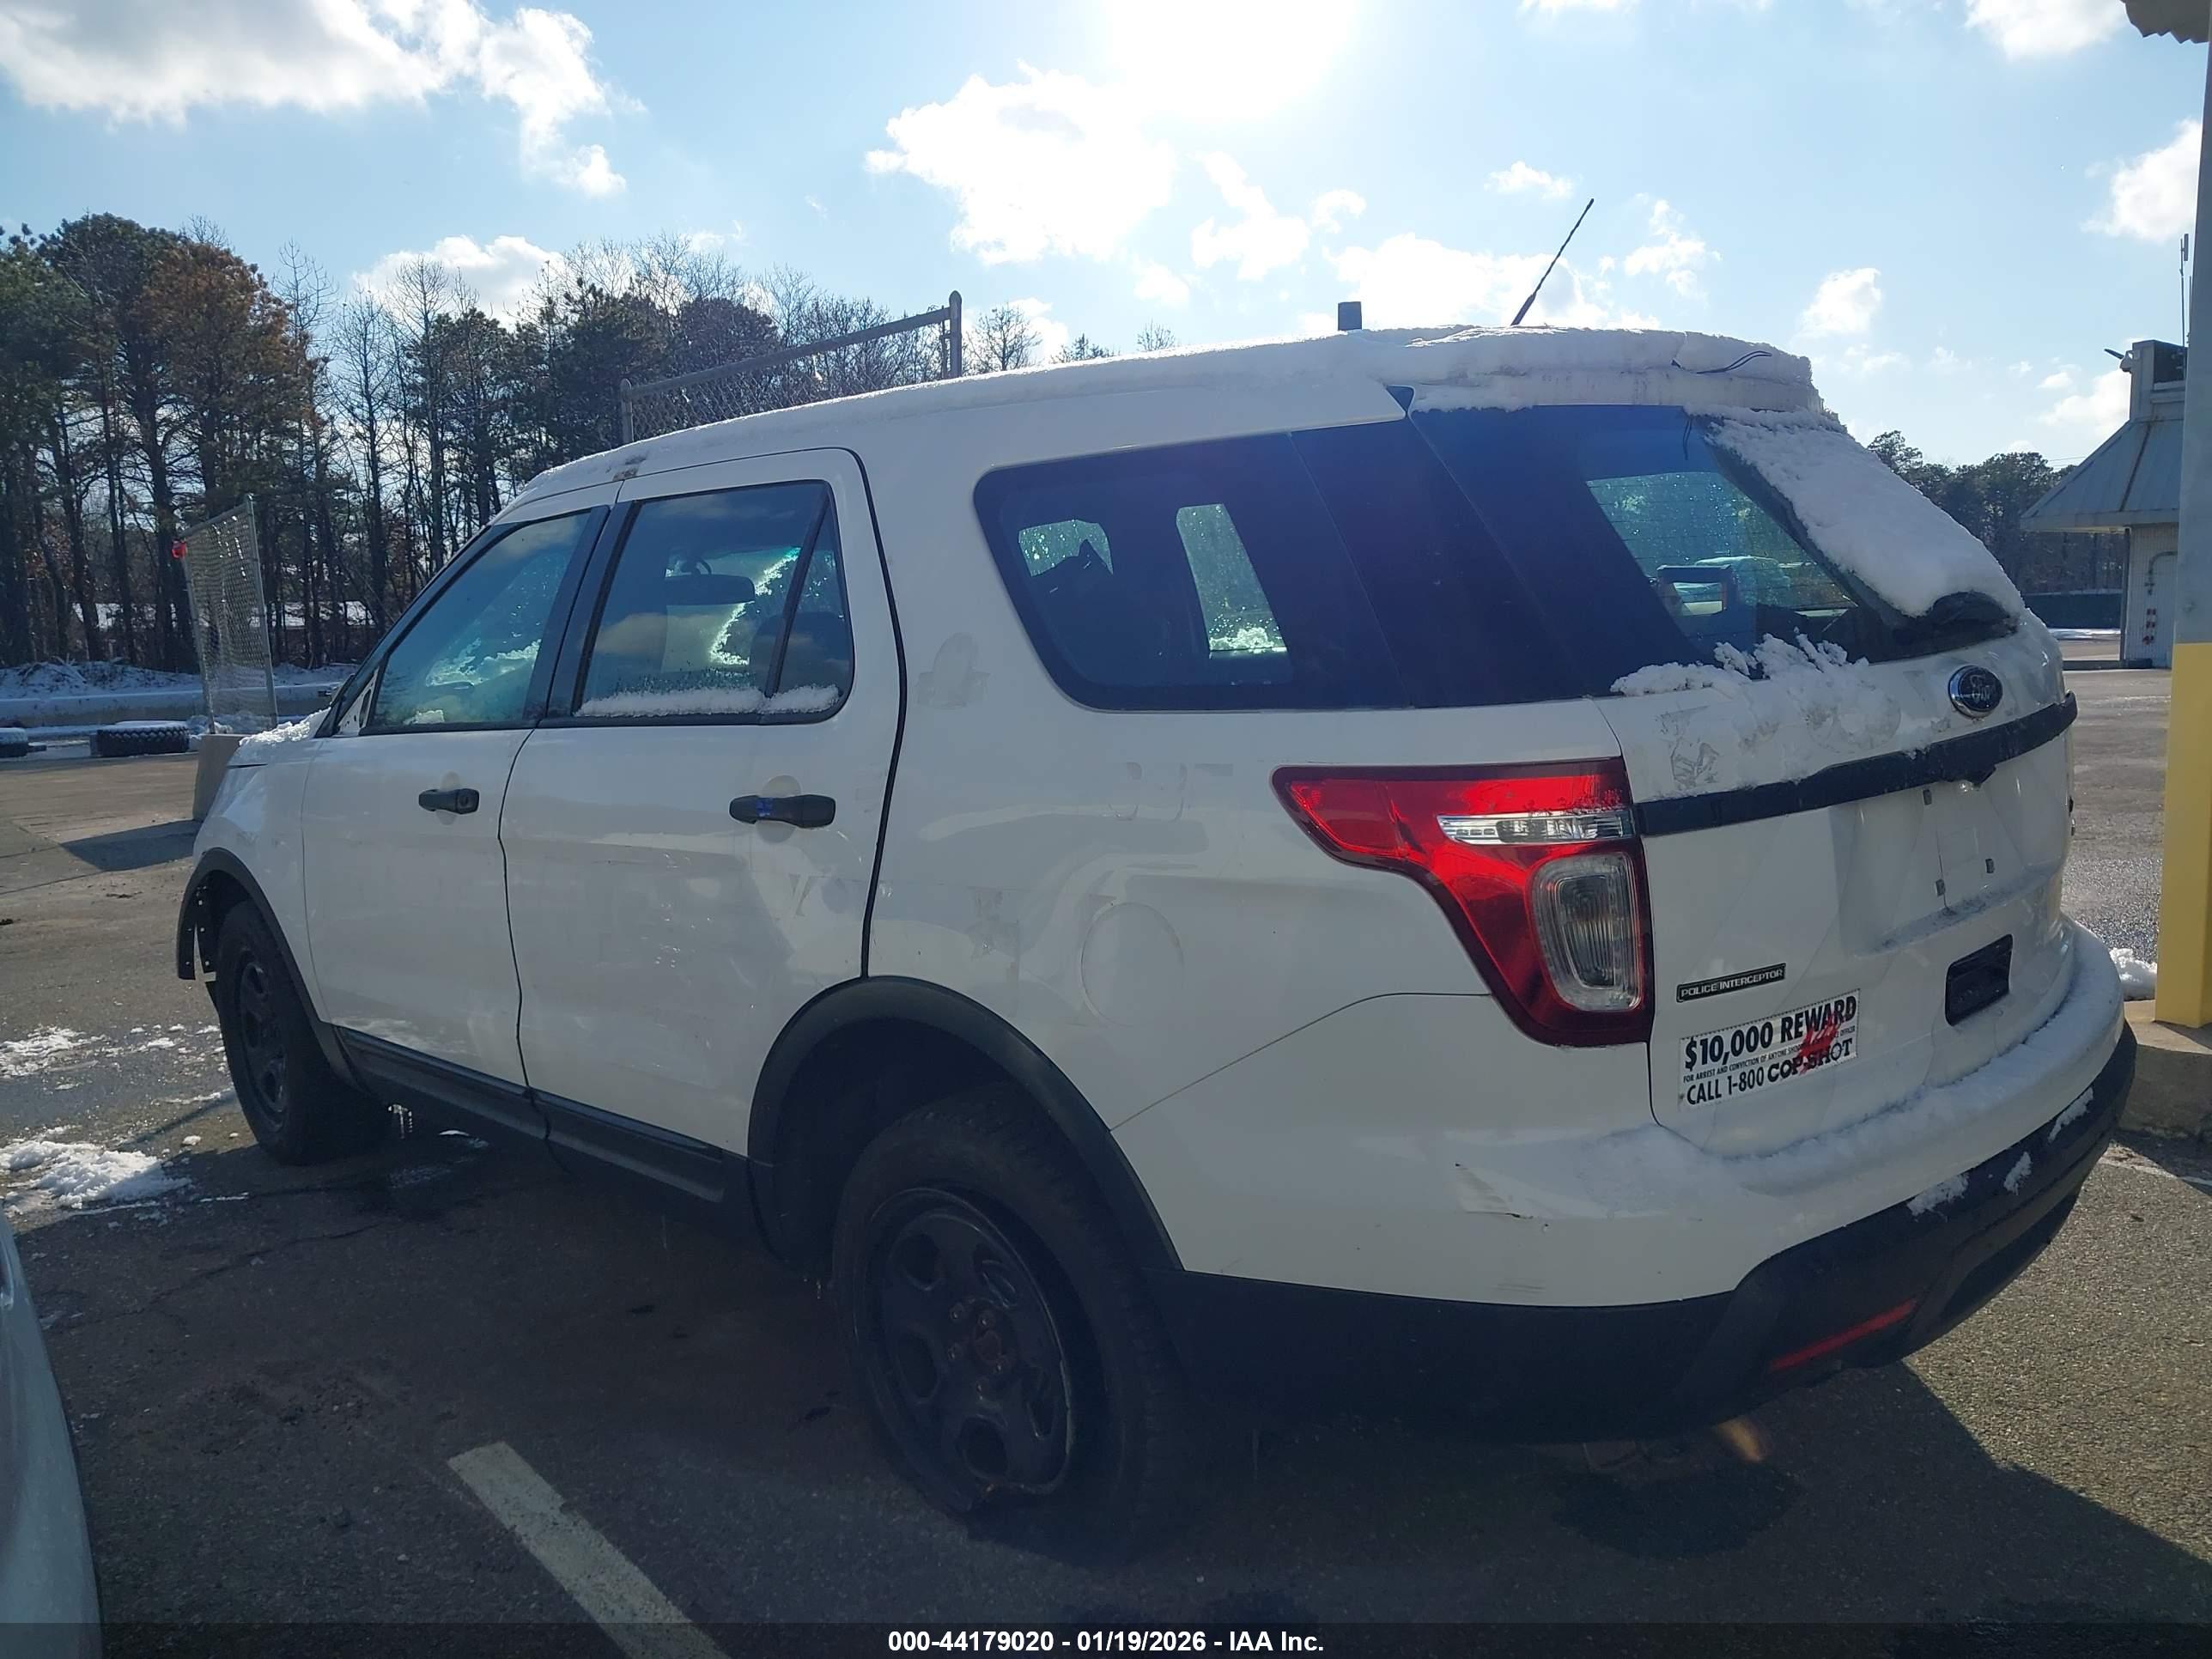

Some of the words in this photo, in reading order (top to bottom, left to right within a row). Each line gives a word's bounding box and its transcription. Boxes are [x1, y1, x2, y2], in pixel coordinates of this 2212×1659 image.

[1680, 982, 1717, 998] POLICE
[1719, 969, 1784, 990] INTERCEPTOR
[1685, 1022, 1773, 1072] $10,000
[1780, 996, 1856, 1043] REWARD
[1683, 1074, 1694, 1083] FOR
[1695, 1069, 1716, 1079] ARREST
[1717, 1066, 1728, 1074] AND
[1729, 1059, 1759, 1072] CONVICTION
[1759, 1054, 1767, 1063] OF
[1686, 1079, 1722, 1104] CALL
[1727, 1066, 1764, 1095] 1-800
